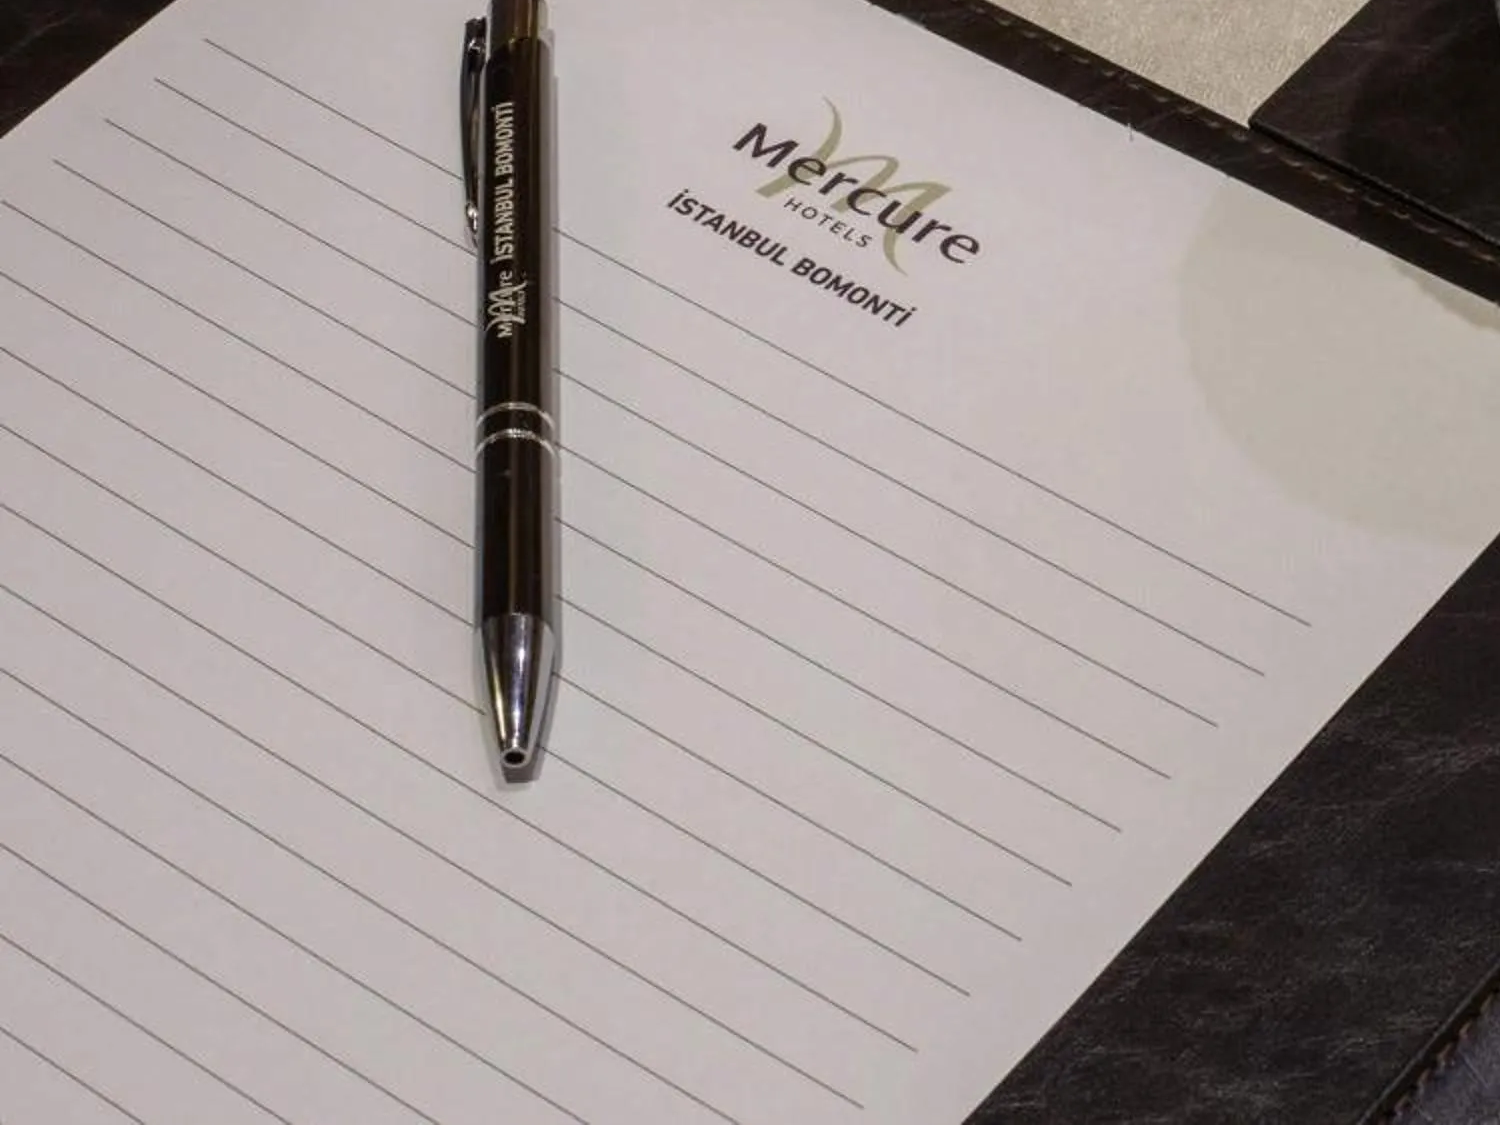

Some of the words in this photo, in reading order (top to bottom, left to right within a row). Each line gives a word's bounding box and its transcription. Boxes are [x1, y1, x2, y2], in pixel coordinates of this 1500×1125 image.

[666, 188, 787, 267] İSTANBUL
[731, 122, 982, 265] Mercure
[783, 195, 874, 249] HOTELS
